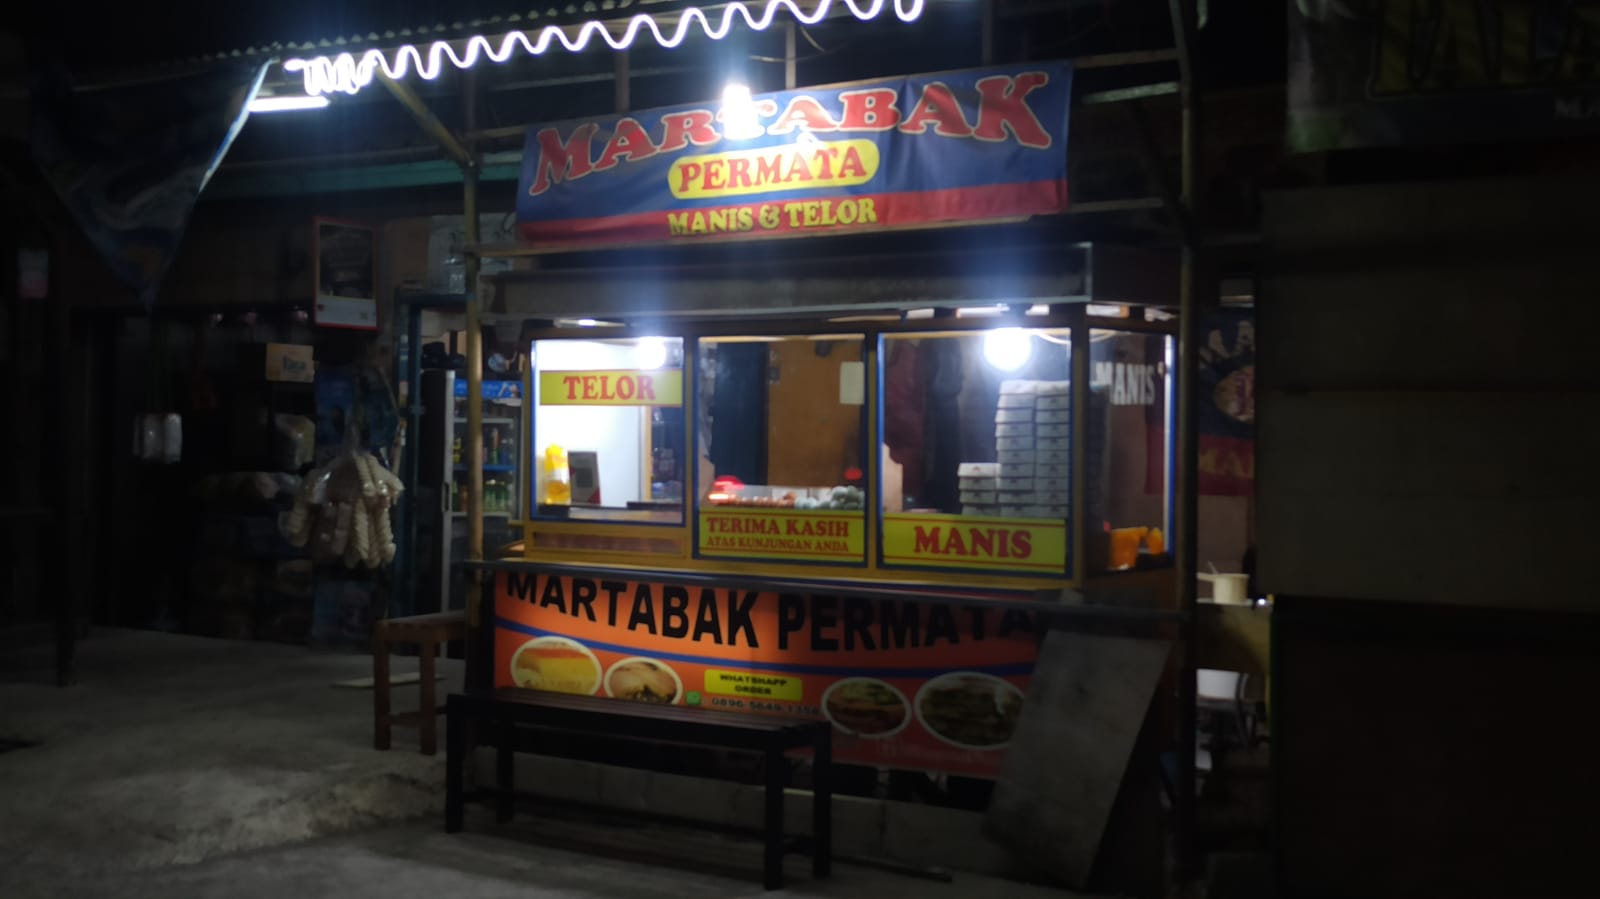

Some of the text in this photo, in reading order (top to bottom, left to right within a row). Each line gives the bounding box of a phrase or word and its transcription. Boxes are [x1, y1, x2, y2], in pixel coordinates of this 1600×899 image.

[678, 146, 867, 193] PERMATA
[667, 198, 878, 235] MANIS & TELOR
[563, 375, 656, 401] TELOR
[707, 517, 850, 538] TERIMA KASIH
[706, 536, 849, 552] ATAS KUNJUNGAN ANDA
[914, 526, 1032, 559] MANIS
[507, 572, 1033, 651] MARTABAK PERMATA
[734, 684, 772, 695] ORDER
